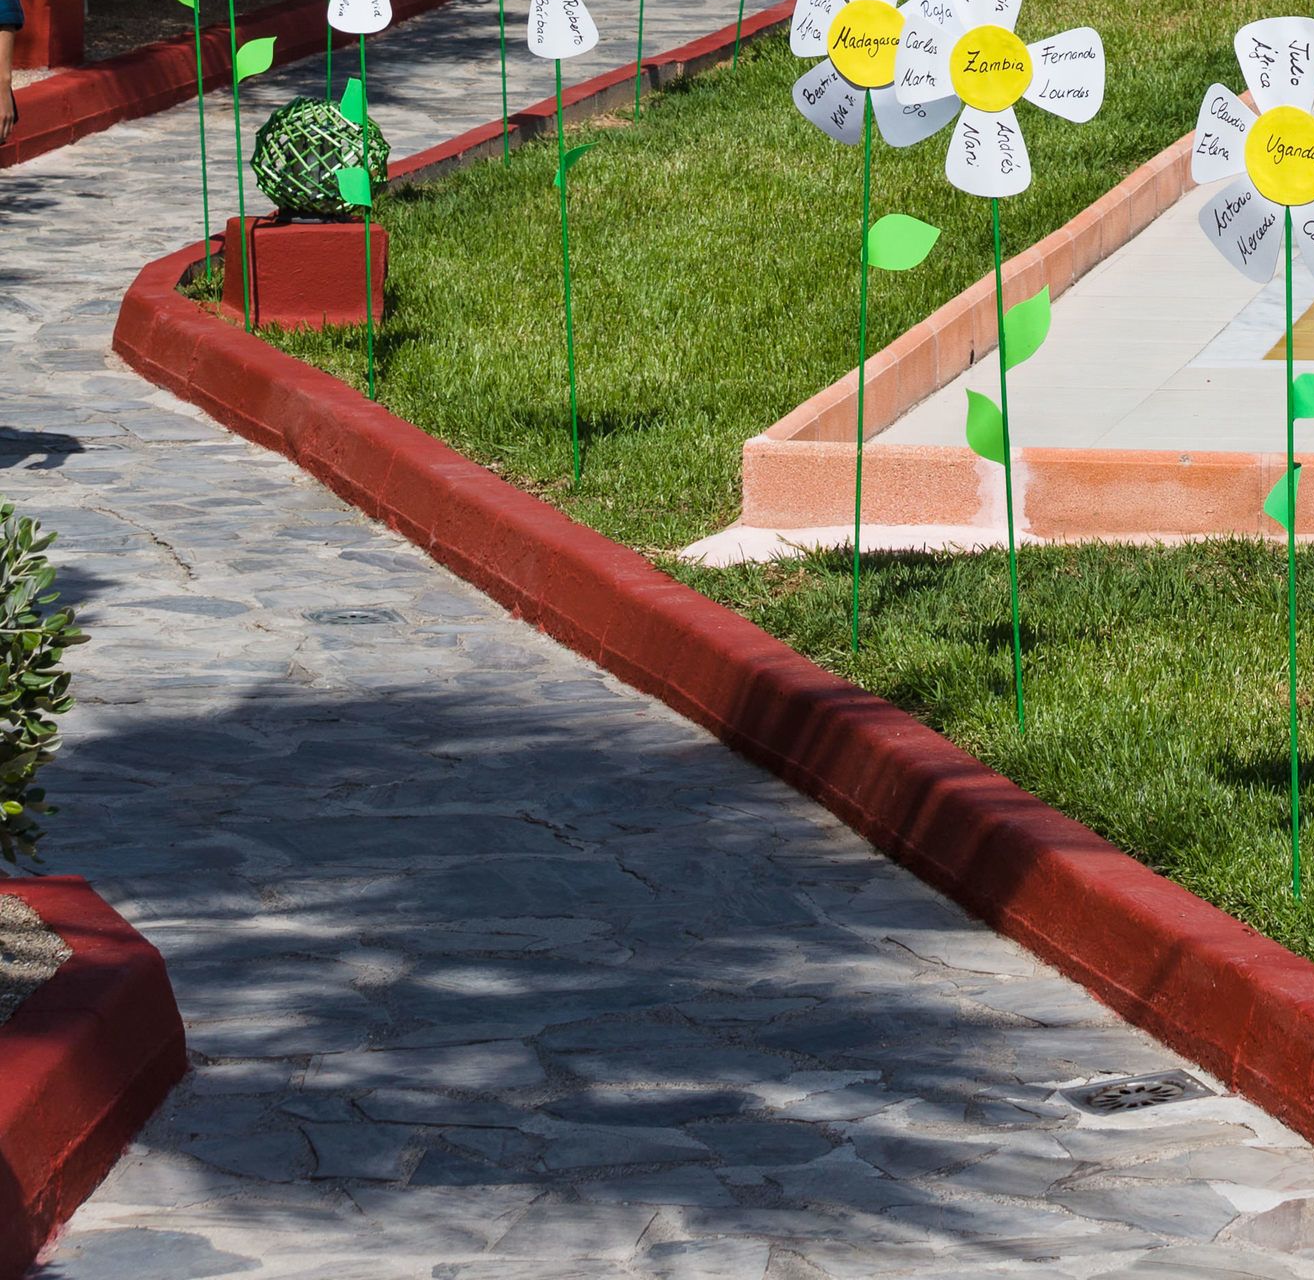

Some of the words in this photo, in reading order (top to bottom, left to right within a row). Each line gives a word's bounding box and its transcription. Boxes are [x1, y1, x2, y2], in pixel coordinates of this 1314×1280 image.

[920, 0, 952, 24] Rafa
[905, 31, 938, 55] Carlos
[1042, 46, 1096, 66] Fernando
[963, 50, 1025, 74] Zambia
[1288, 40, 1310, 86] Julio
[803, 72, 838, 105] Beatriz
[901, 70, 936, 87] Marta
[1039, 79, 1089, 100] Lourdes
[1210, 96, 1246, 133] Claudio
[996, 120, 1021, 175] Andrés
[1196, 134, 1230, 160] Elena
[1214, 191, 1252, 236] Antonio
[1236, 212, 1277, 264] Mercedes
